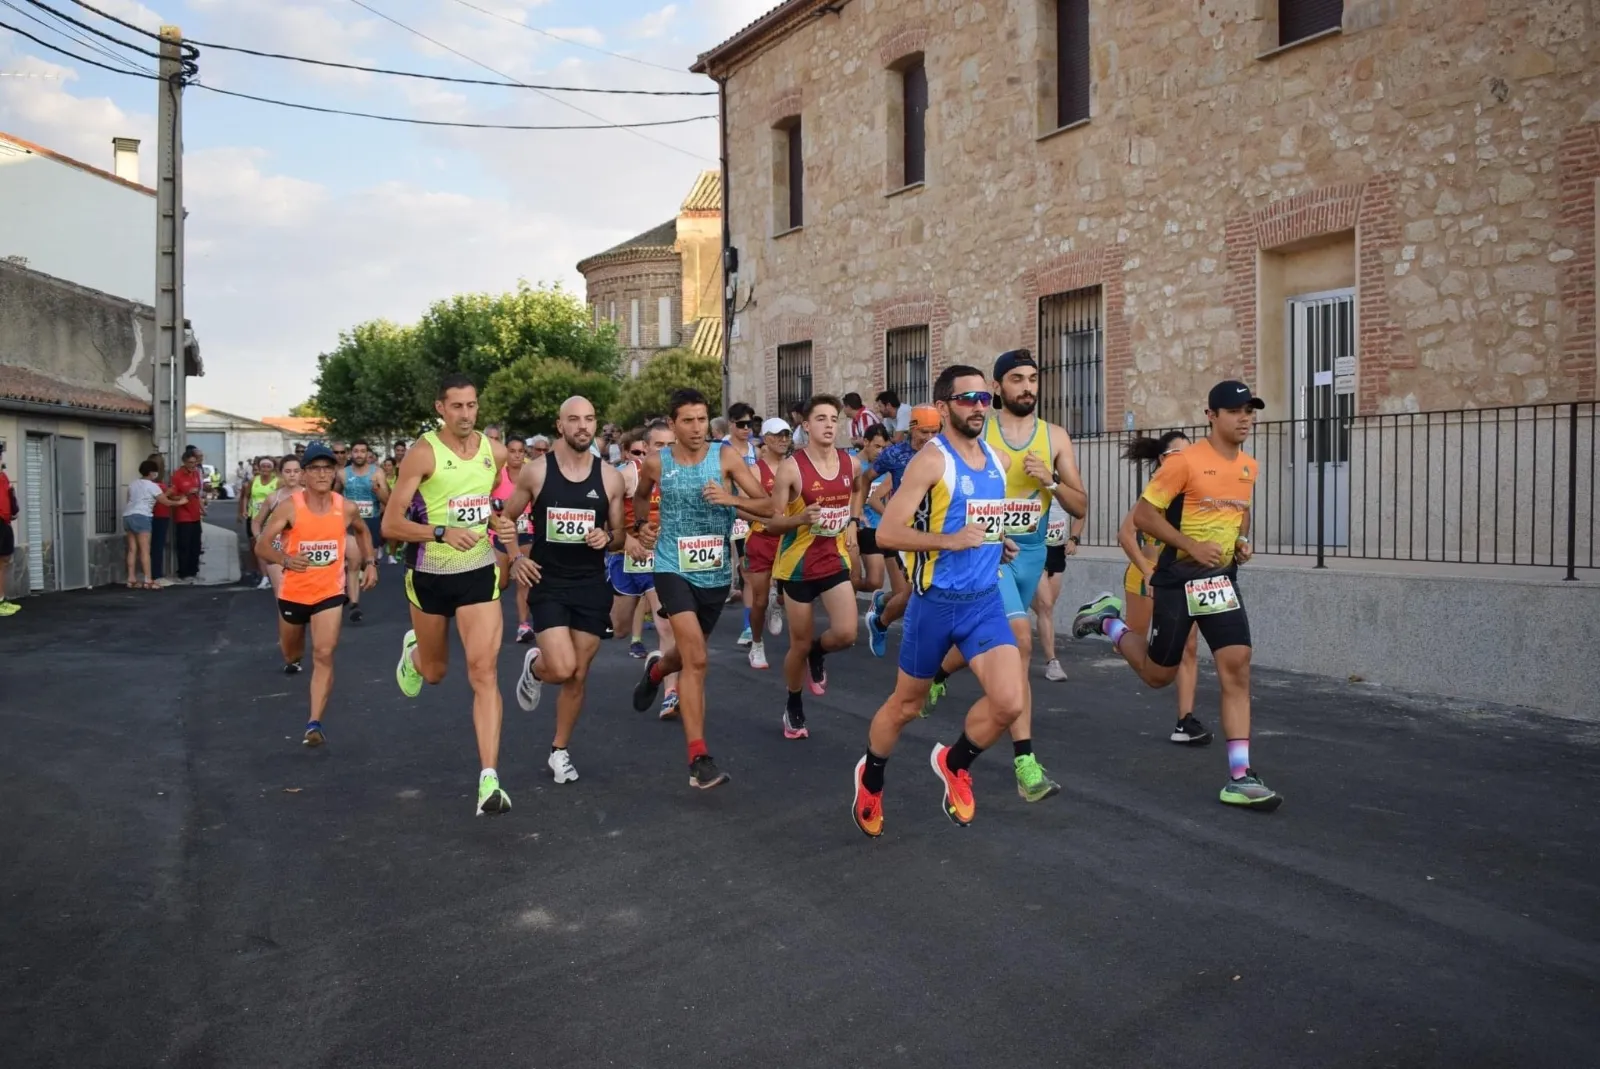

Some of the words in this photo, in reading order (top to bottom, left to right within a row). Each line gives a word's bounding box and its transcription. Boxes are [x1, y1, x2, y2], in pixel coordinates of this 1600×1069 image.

[448, 496, 489, 508] bedunia
[457, 507, 482, 521] 231
[548, 510, 595, 521] bedunia
[1004, 512, 1031, 526] 228
[556, 521, 585, 535] 286
[821, 519, 844, 530] 401
[1048, 529, 1061, 538] 49
[299, 543, 337, 551] bedunia
[679, 538, 723, 551] bedunia
[307, 550, 331, 561] 289
[689, 548, 716, 563] 204
[938, 591, 974, 601] NIKE
[1197, 589, 1226, 607] 291
